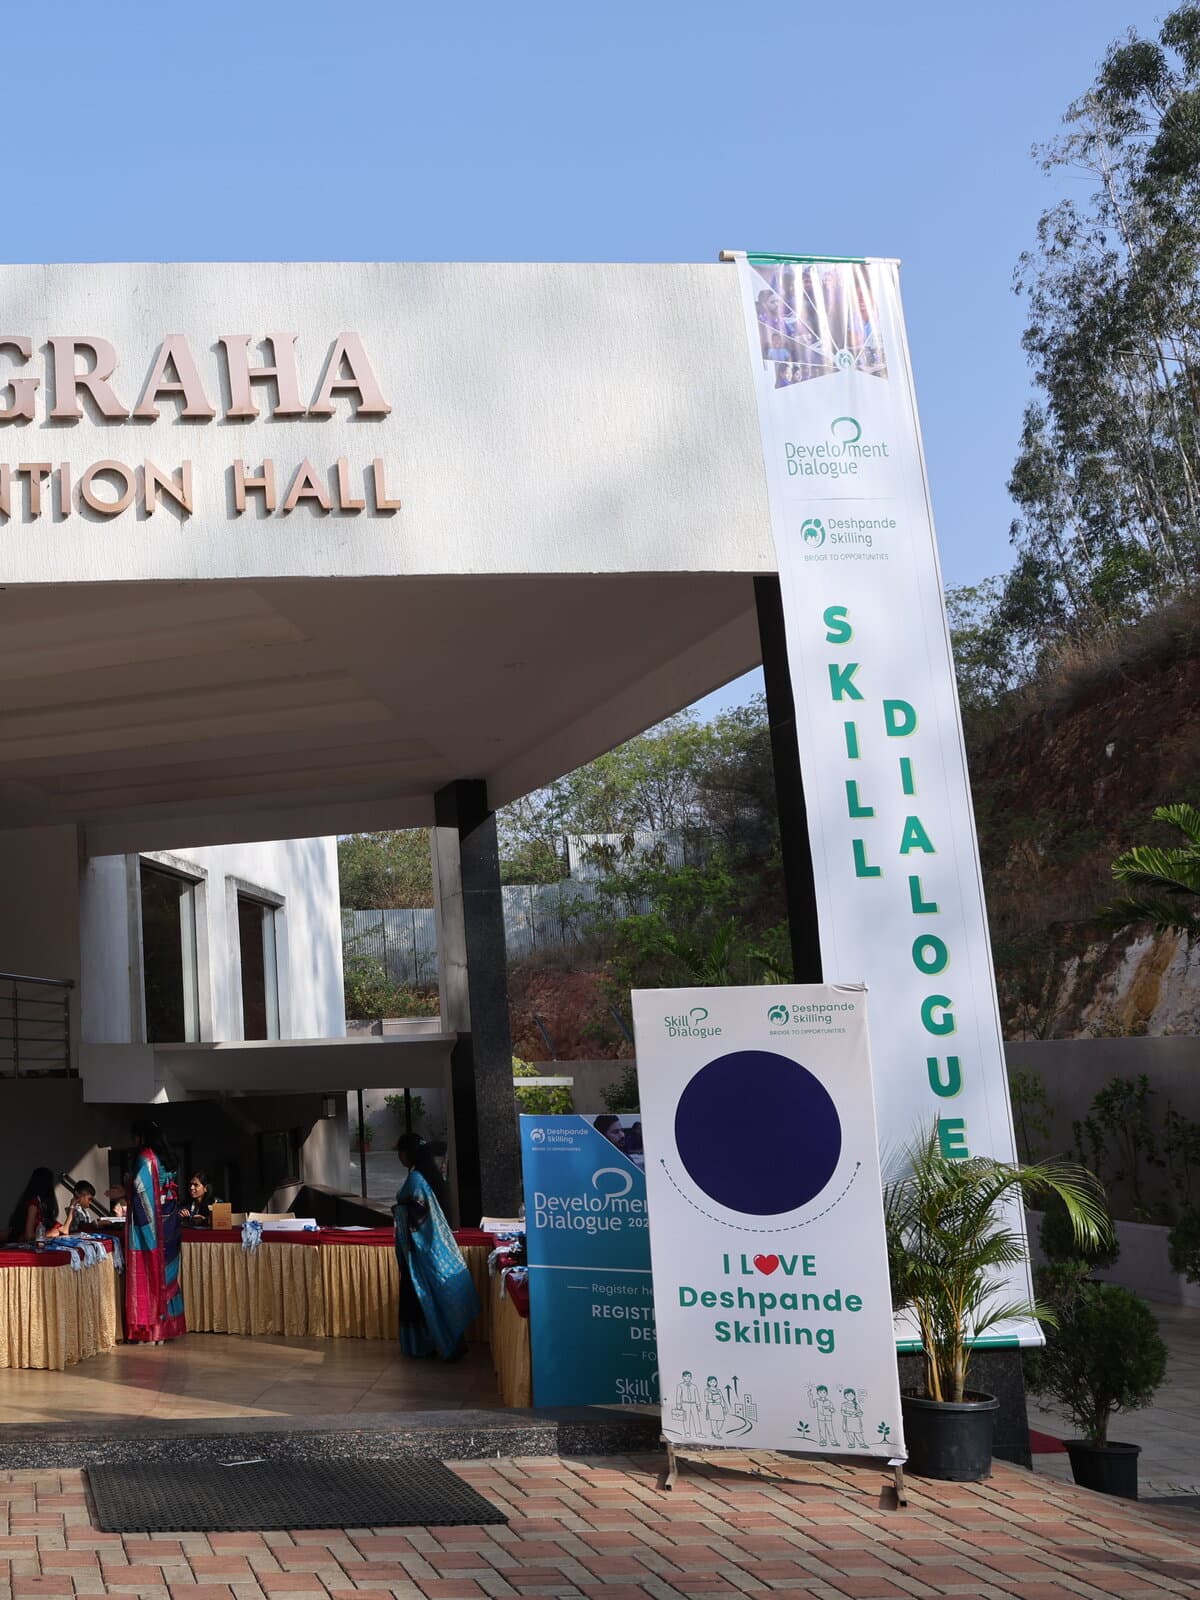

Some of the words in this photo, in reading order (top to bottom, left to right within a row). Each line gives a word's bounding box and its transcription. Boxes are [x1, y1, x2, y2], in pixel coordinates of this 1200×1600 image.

[786, 459, 858, 478] Dialogue
[232, 458, 402, 514] HALL
[828, 517, 896, 533] Deshpande
[830, 532, 873, 547] Skilling
[823, 605, 882, 878] SKILL
[883, 699, 970, 1159] DIALOGUE
[792, 1003, 855, 1014] Deshpande
[664, 1015, 689, 1027] Skill
[793, 1014, 832, 1024] Skilling
[668, 1025, 722, 1038] Dialogue
[535, 1211, 622, 1235] Dialogue
[723, 1254, 730, 1274] I
[591, 1284, 638, 1296] Register
[679, 1286, 863, 1316] Deshpande
[714, 1319, 835, 1354] Skilling
[615, 1378, 649, 1396] Skill
